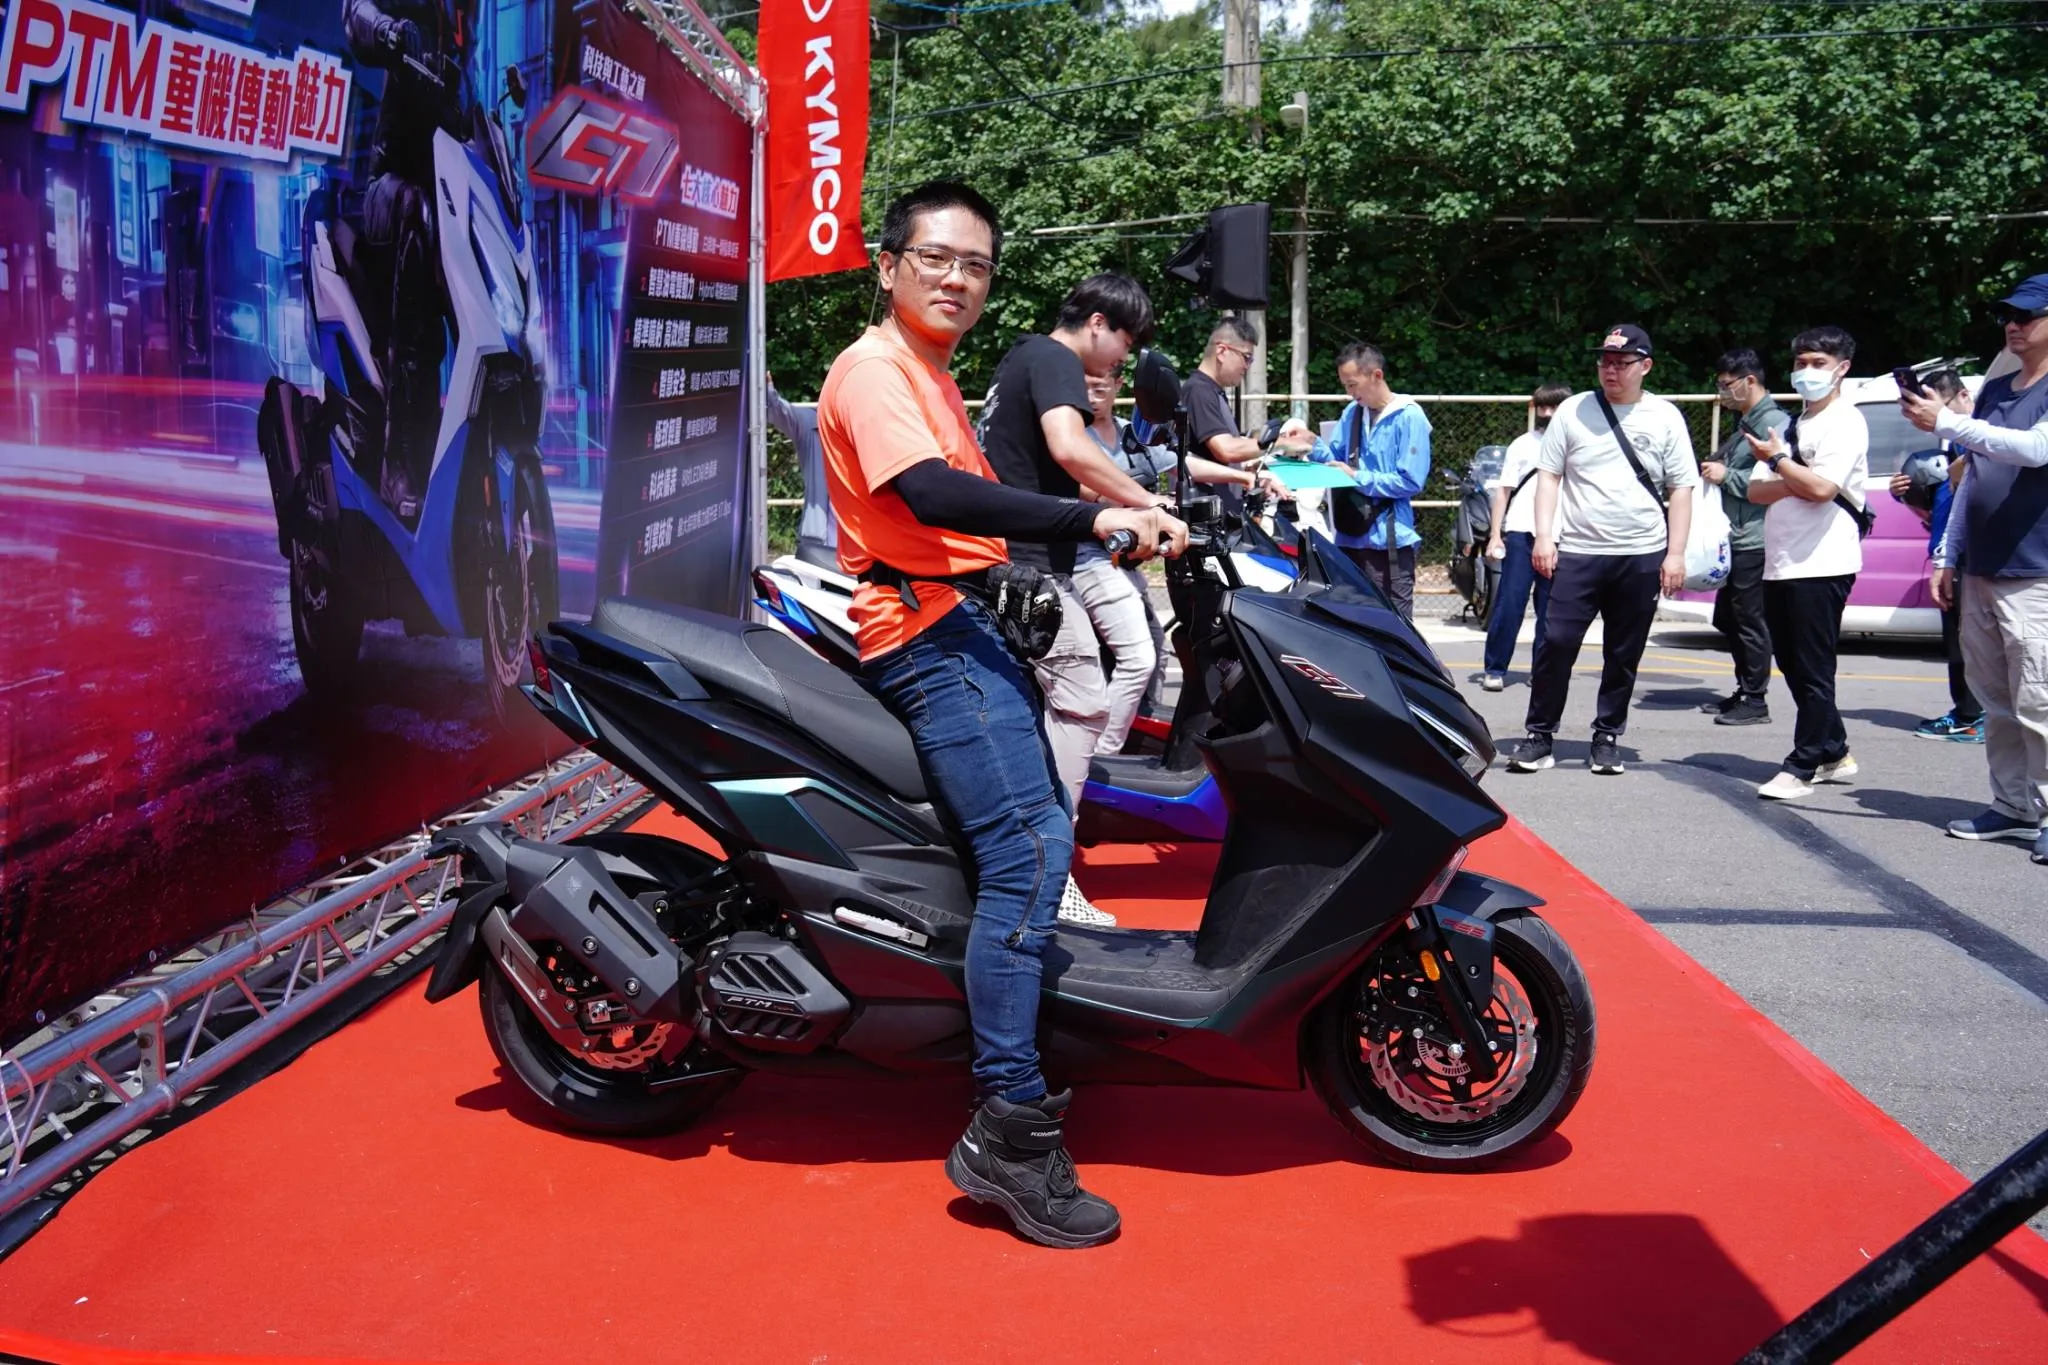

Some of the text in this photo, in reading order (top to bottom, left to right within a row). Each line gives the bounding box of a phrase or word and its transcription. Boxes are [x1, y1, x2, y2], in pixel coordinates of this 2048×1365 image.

[5, 0, 347, 151] PTM重機傳動魅力
[804, 35, 842, 256] KYMCO
[727, 995, 772, 1008] PTM
